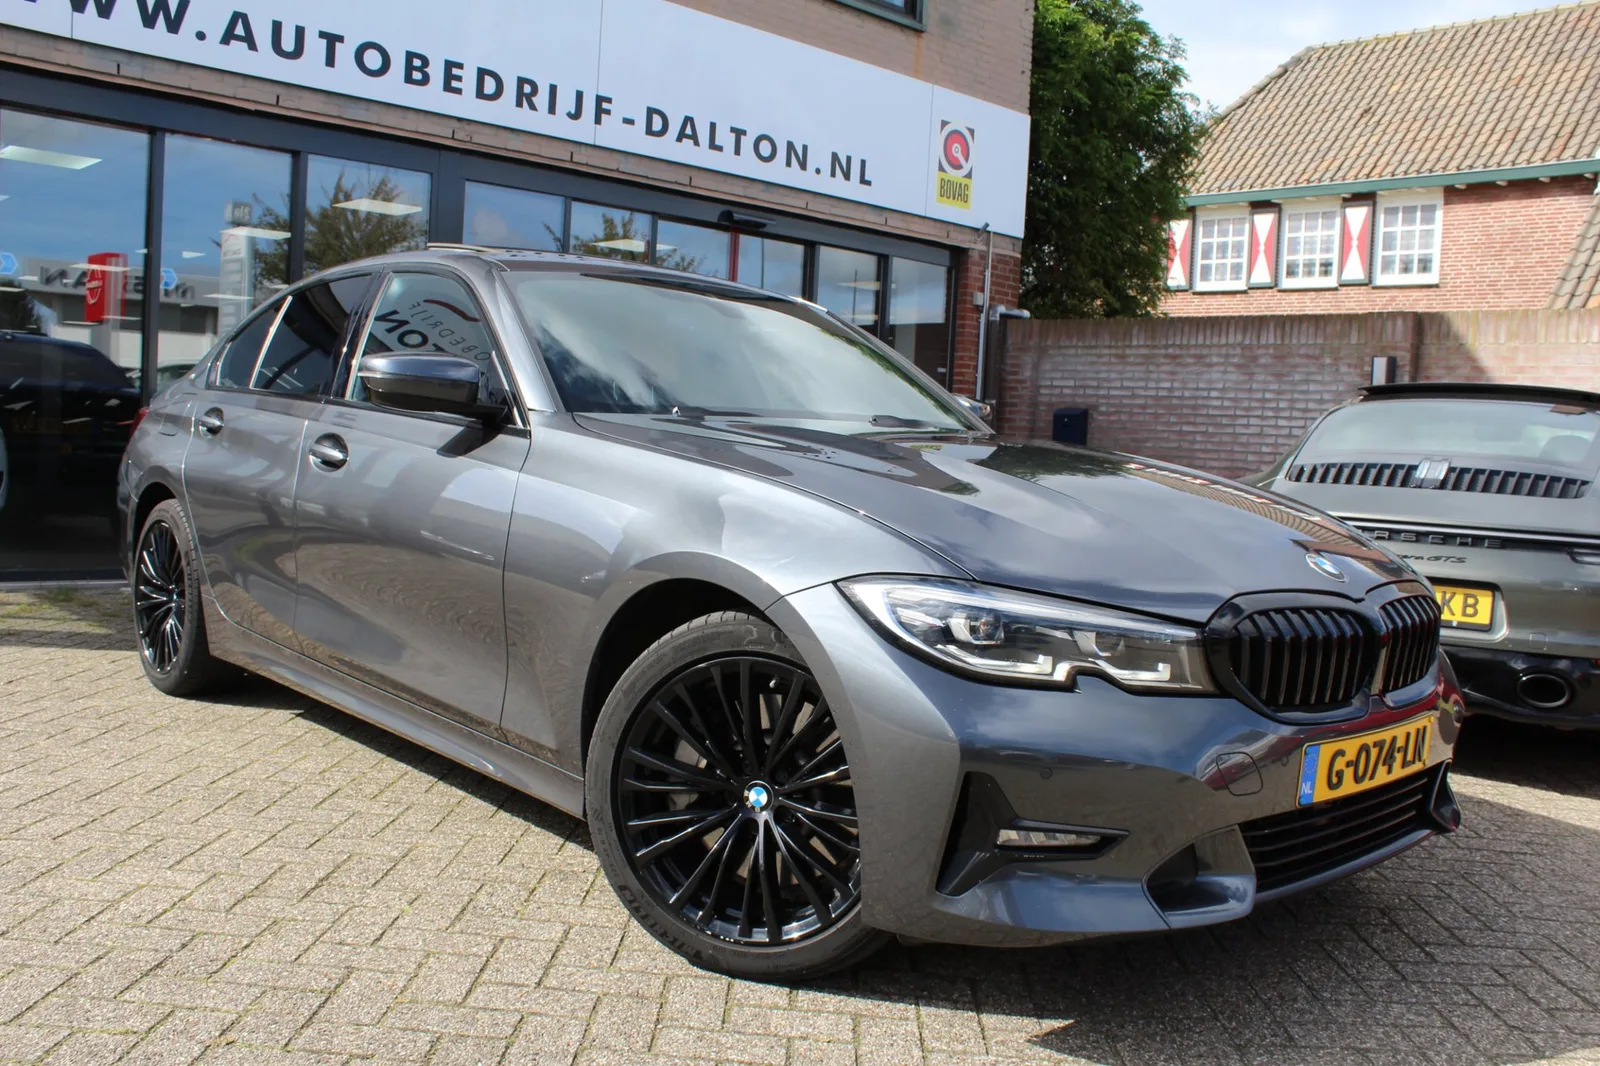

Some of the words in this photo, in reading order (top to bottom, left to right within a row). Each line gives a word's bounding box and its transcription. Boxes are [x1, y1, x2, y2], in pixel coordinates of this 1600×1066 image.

[24, 0, 872, 187] W.AUTOBEDRIJF-DALTON.NL
[939, 178, 969, 204] BOVAG
[1374, 530, 1502, 548] RSCHE
[1326, 725, 1428, 791] G-074-LN
[1300, 781, 1313, 795] NL
